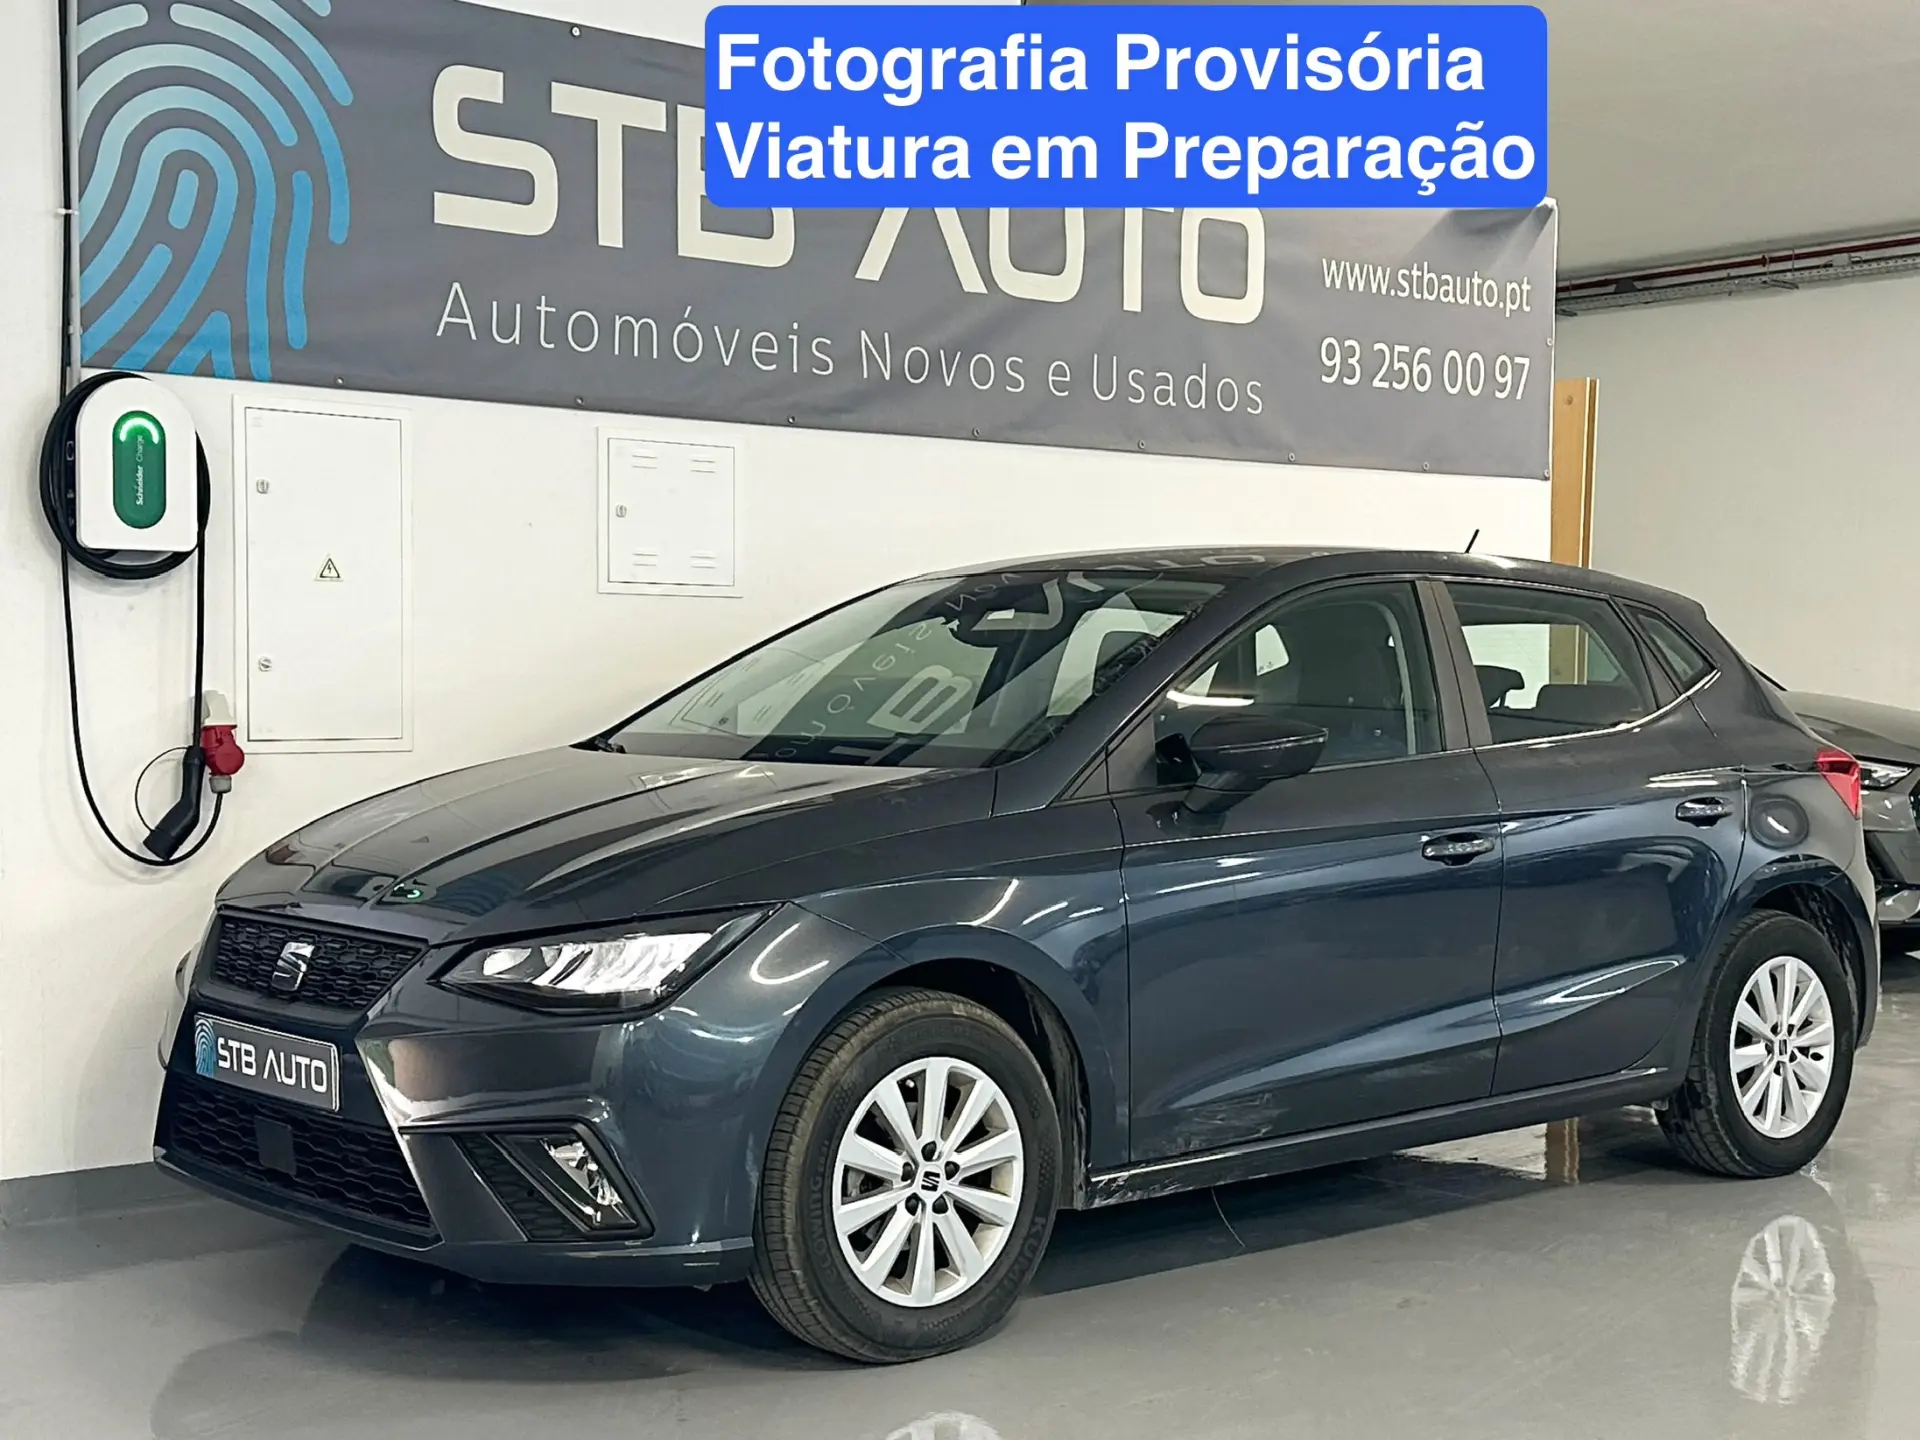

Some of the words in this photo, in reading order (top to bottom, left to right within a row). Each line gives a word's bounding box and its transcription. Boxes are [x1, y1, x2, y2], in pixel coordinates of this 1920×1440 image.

[1321, 258, 1532, 318] www.stbauto.pt
[436, 282, 834, 376] Automóveis
[860, 329, 1025, 393] Novos
[1047, 359, 1072, 397] e
[1093, 353, 1263, 415] Usados
[1321, 337, 1361, 386] 93
[1372, 342, 1432, 393] 256
[1443, 349, 1485, 397] 00
[1494, 354, 1530, 400] 97
[217, 1036, 257, 1077] STB
[262, 1048, 328, 1094] AUTO
